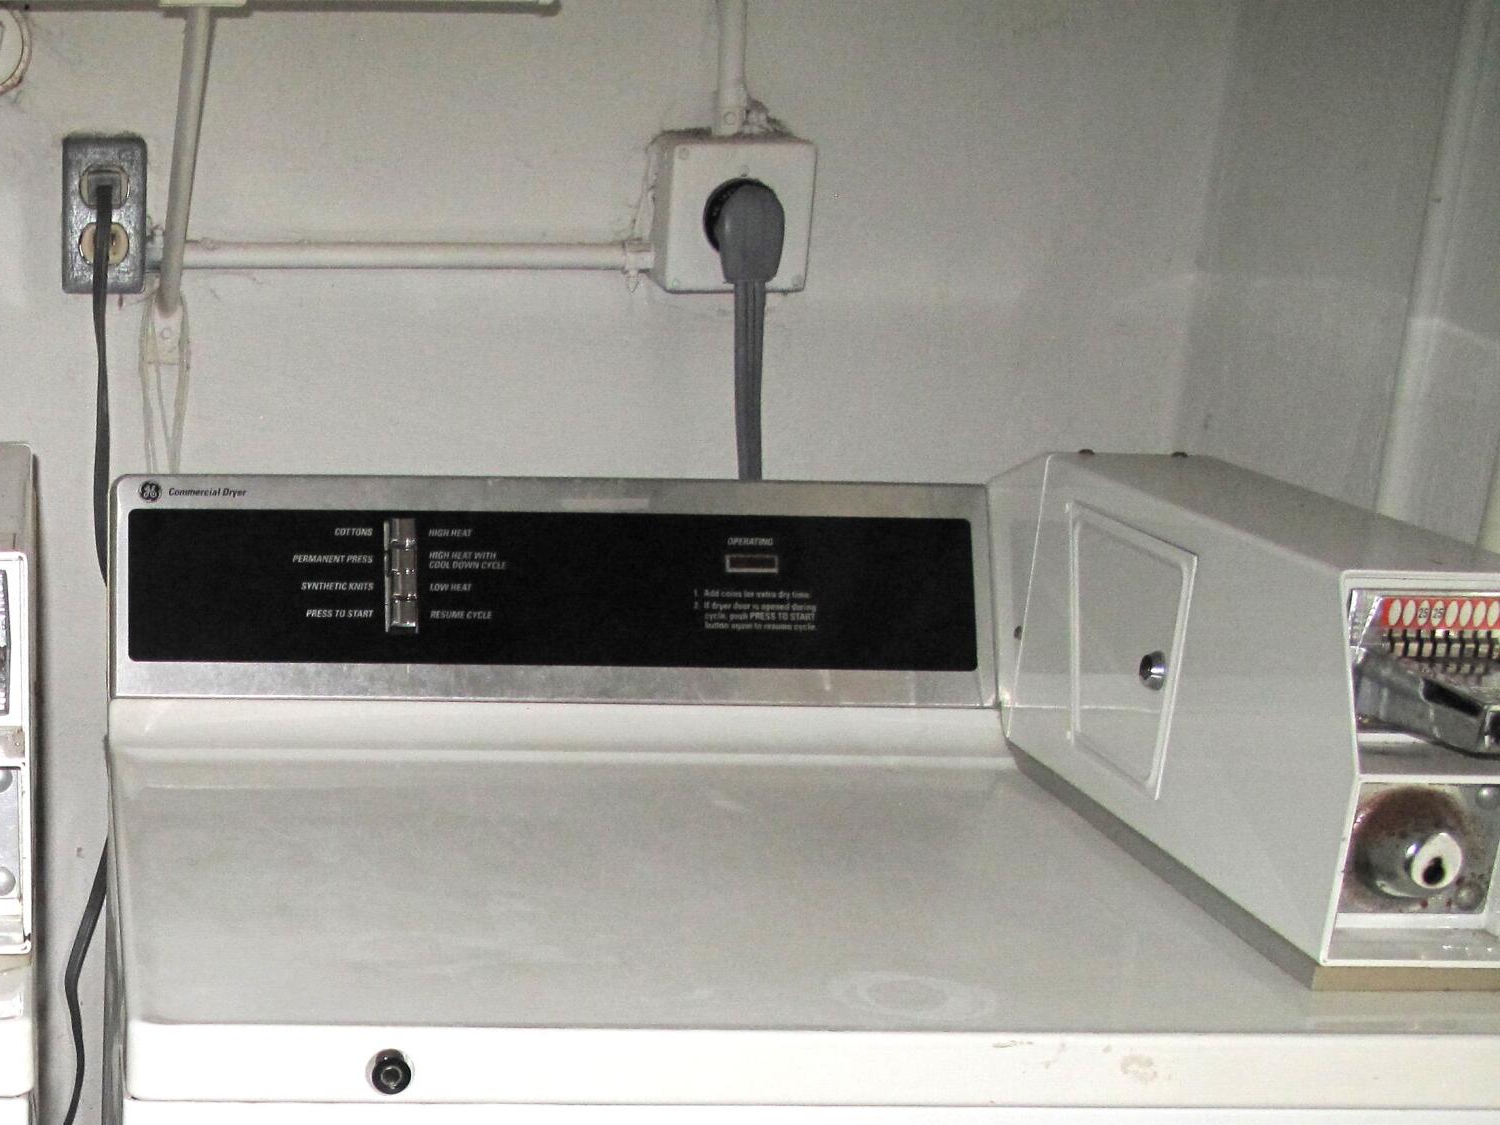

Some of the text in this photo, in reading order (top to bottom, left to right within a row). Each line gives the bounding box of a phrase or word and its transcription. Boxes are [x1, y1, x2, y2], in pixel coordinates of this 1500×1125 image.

[169, 488, 220, 496] Commercial
[223, 488, 247, 498] Dryer
[334, 528, 373, 536] COTTONS
[429, 529, 472, 537] HIGH HEAT
[727, 537, 773, 546] OPERATING
[293, 555, 373, 563] PERMANENT PRESS
[429, 552, 497, 560] HIGH HEAT WITH
[429, 561, 507, 570] COOL DOWN CYCLE
[301, 582, 374, 591] SYNTHETIC KNITS
[429, 583, 472, 591] LOW HEAT
[704, 589, 719, 598] Add
[720, 590, 742, 598] coins
[778, 590, 790, 601] dry
[712, 602, 732, 612] dryer
[306, 609, 332, 618] PRESS
[347, 610, 374, 618] START
[430, 611, 492, 619] RESUME CYCLE
[750, 612, 775, 620] PRESS
[777, 612, 788, 620] TO
[790, 613, 815, 621] START
[1419, 608, 1443, 619] 25 25
